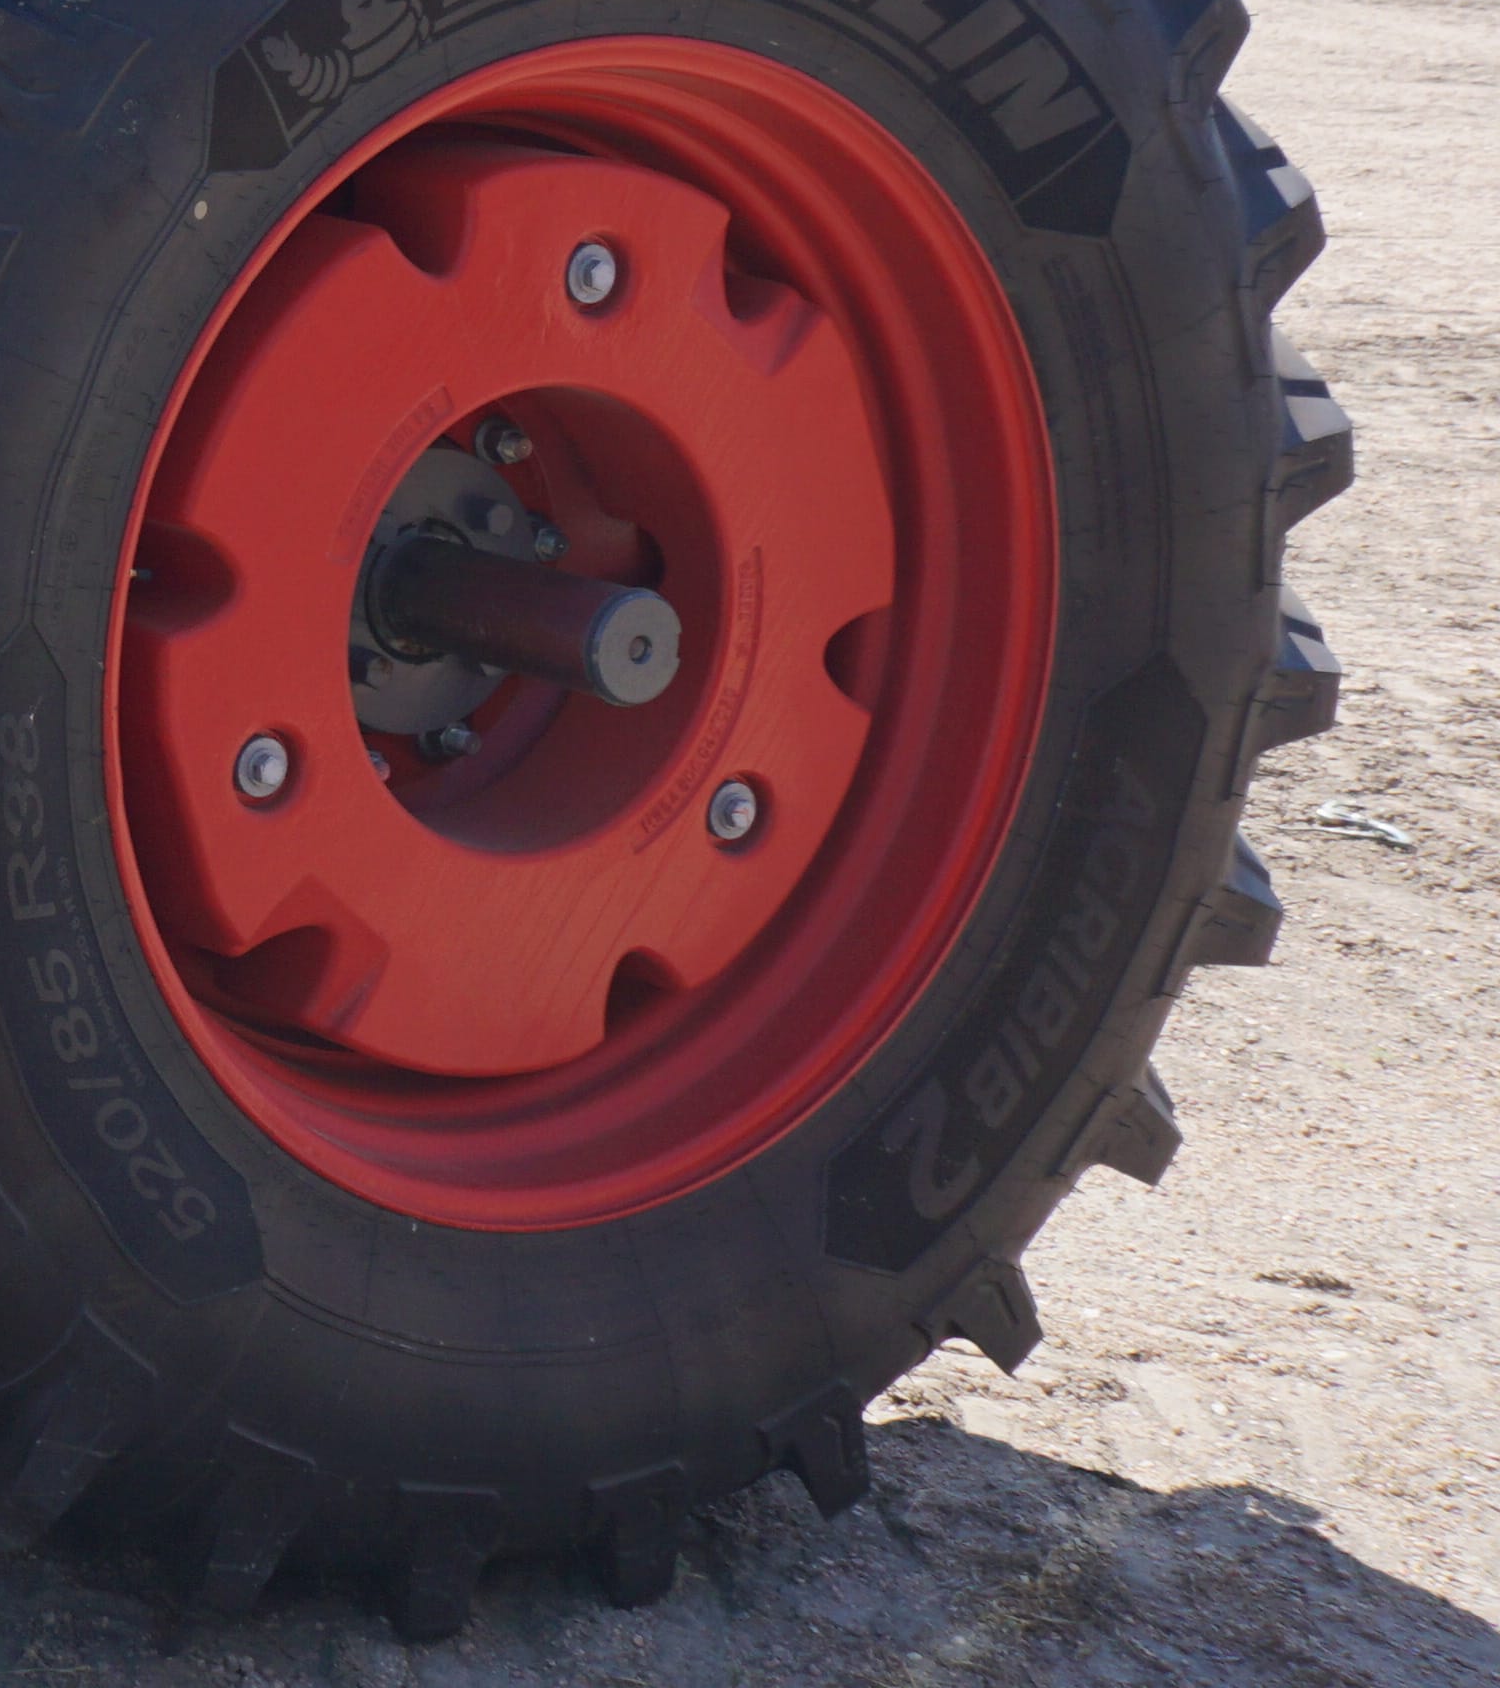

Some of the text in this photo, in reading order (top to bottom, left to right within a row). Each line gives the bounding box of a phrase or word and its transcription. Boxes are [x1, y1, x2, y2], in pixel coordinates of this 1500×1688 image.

[28, 948, 216, 1242] 520/85
[881, 756, 1156, 1221] AGRIBIB 2
